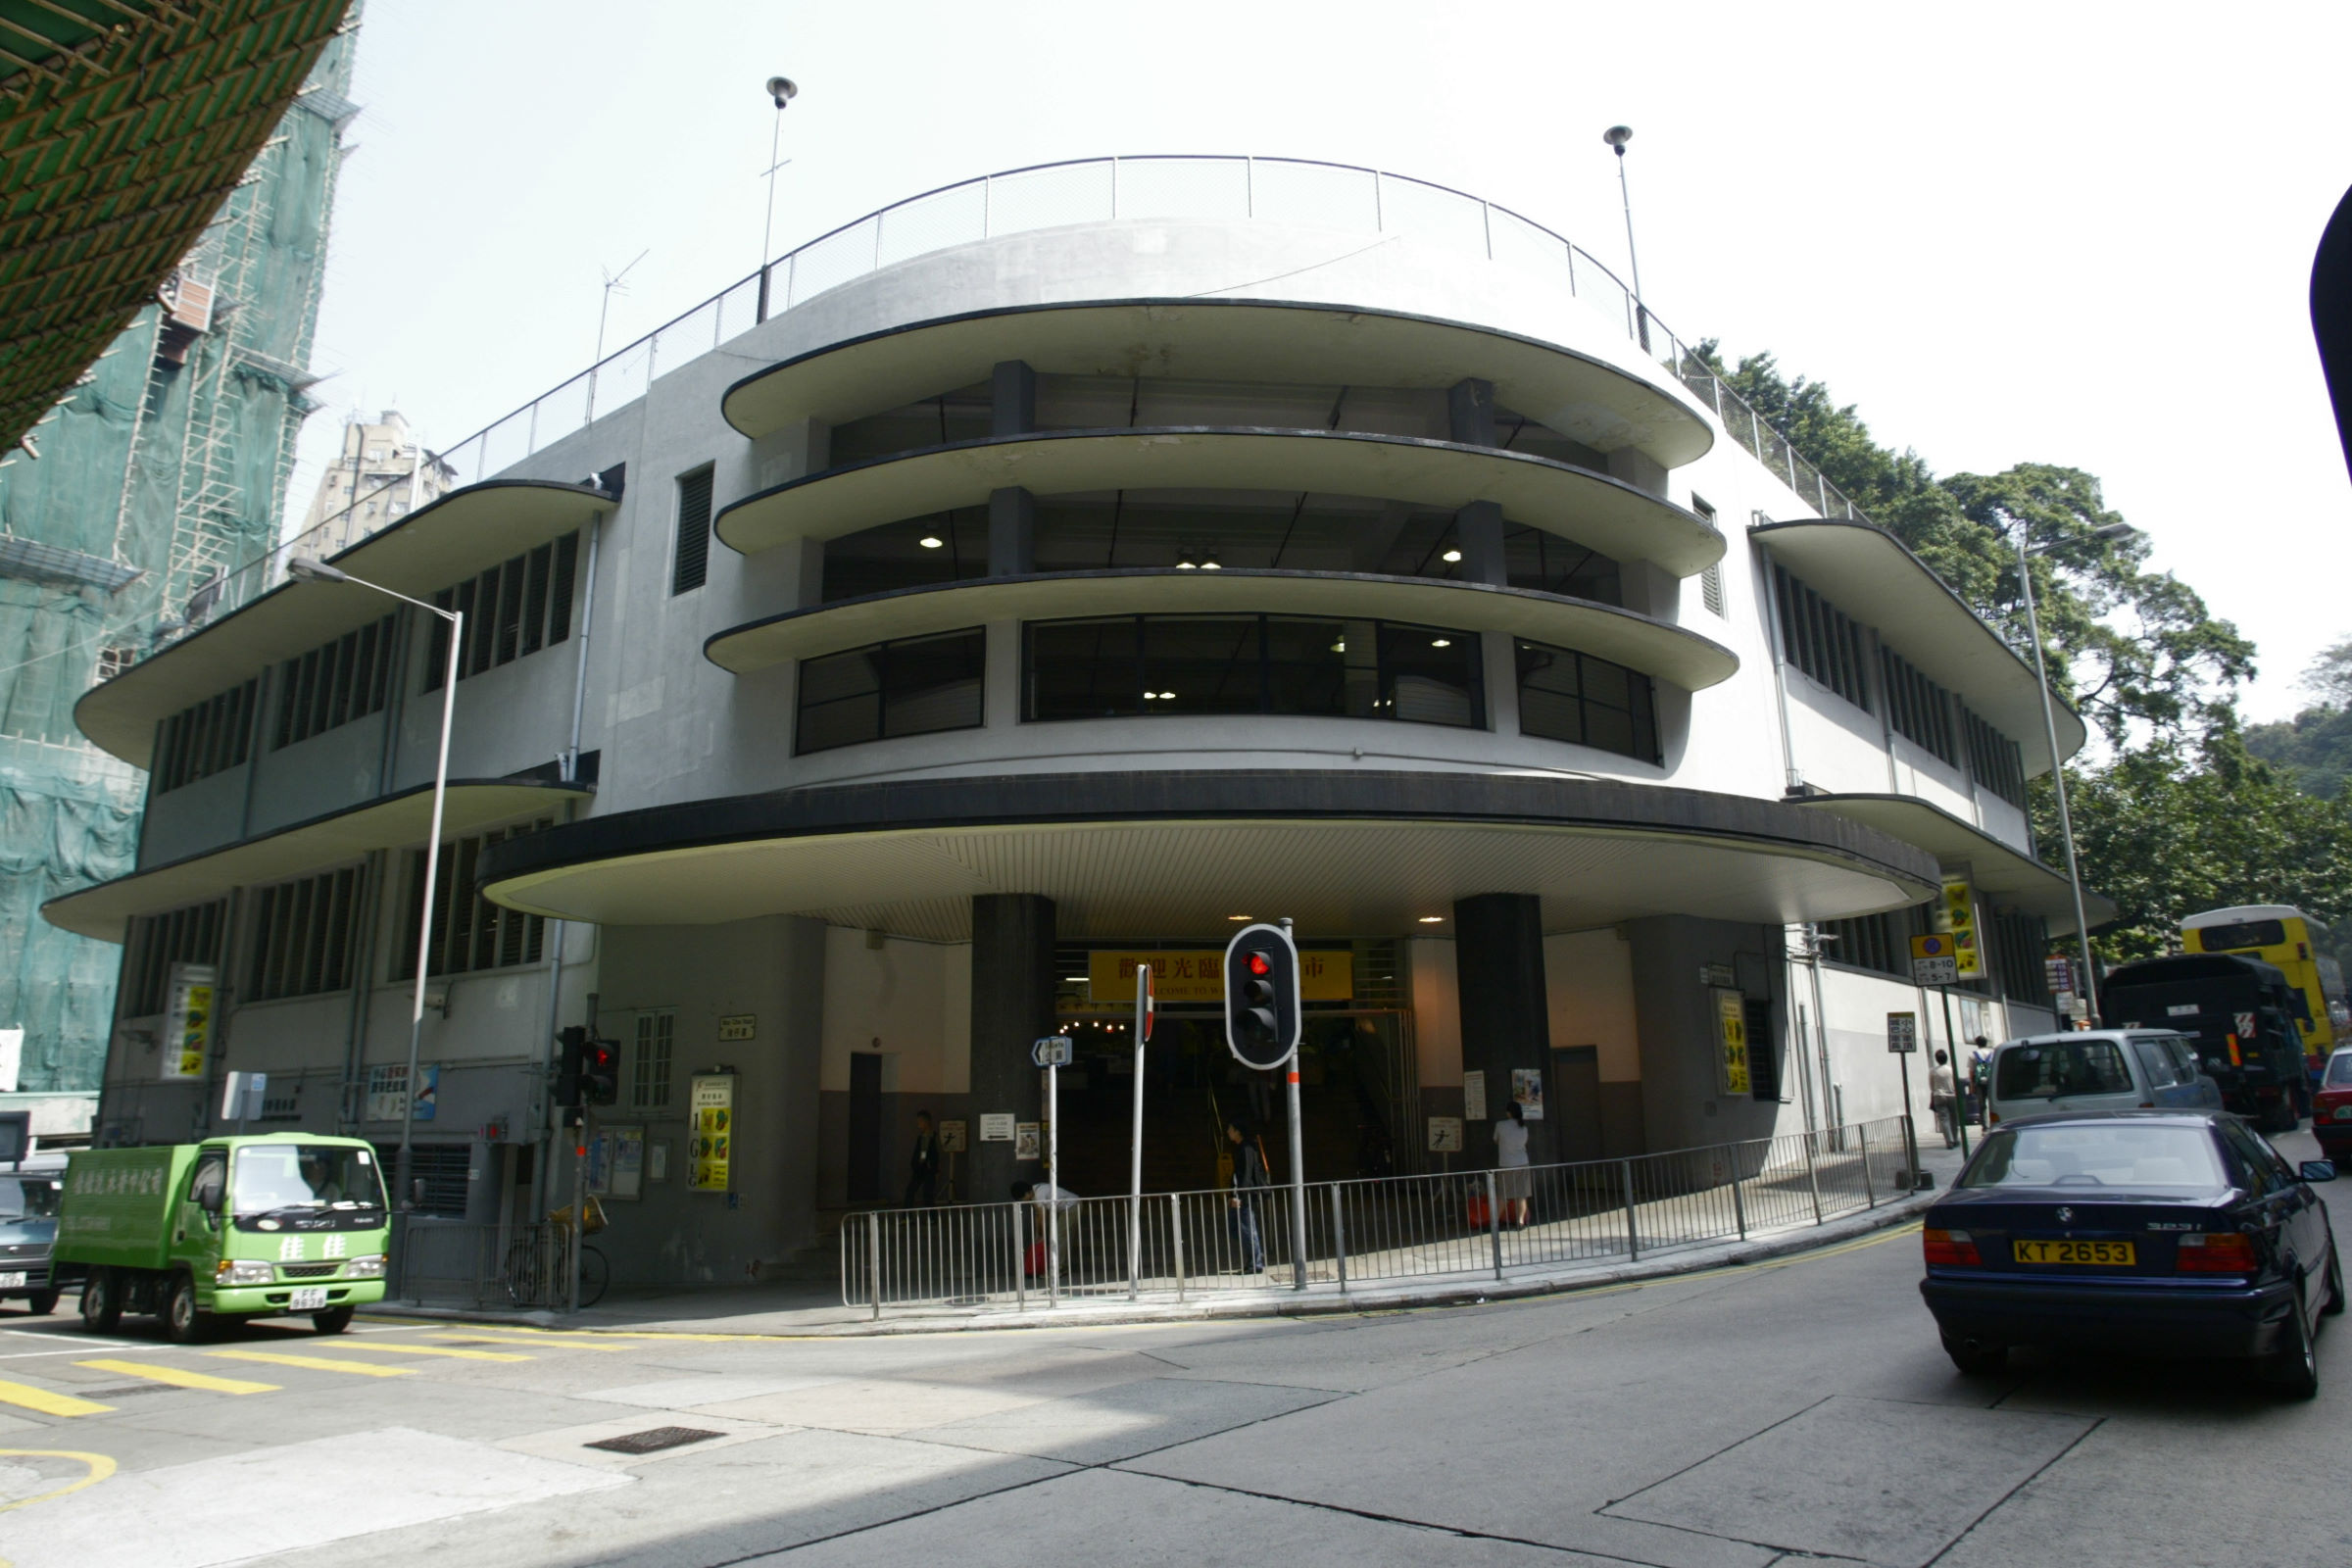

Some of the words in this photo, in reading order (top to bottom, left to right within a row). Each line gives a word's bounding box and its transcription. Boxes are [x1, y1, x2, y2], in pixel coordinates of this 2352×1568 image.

[1154, 986, 1192, 996] LCOME
[2018, 1243, 2050, 1261] KT
[2059, 1243, 2130, 1263] 2653
